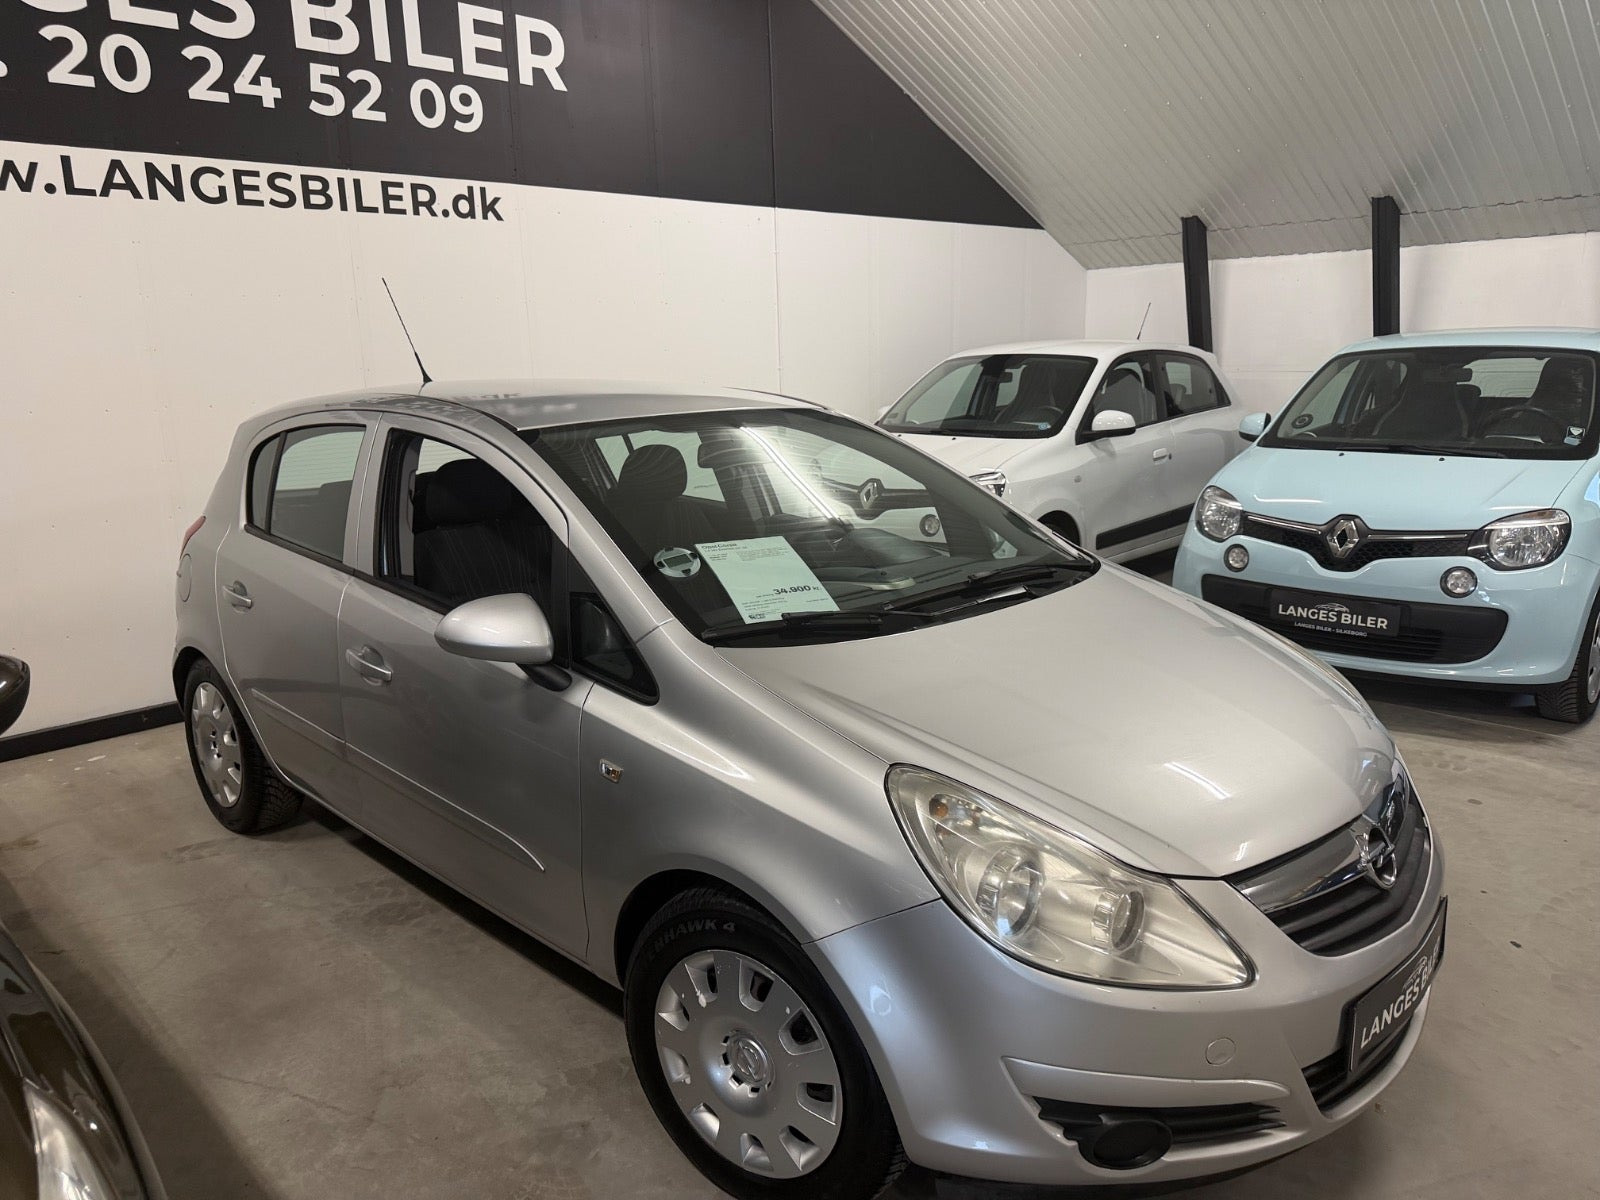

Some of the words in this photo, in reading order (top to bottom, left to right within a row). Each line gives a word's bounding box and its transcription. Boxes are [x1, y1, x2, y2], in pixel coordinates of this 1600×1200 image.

[38, 24, 151, 94] 20
[181, 45, 282, 109] 24
[308, 62, 387, 122] 52
[409, 78, 484, 133] 09
[292, 0, 568, 92] BILER
[1278, 603, 1337, 622] LANGES
[1341, 612, 1388, 629] BILER
[1294, 621, 1315, 629] LANGES
[1361, 977, 1420, 1048] LANGES
